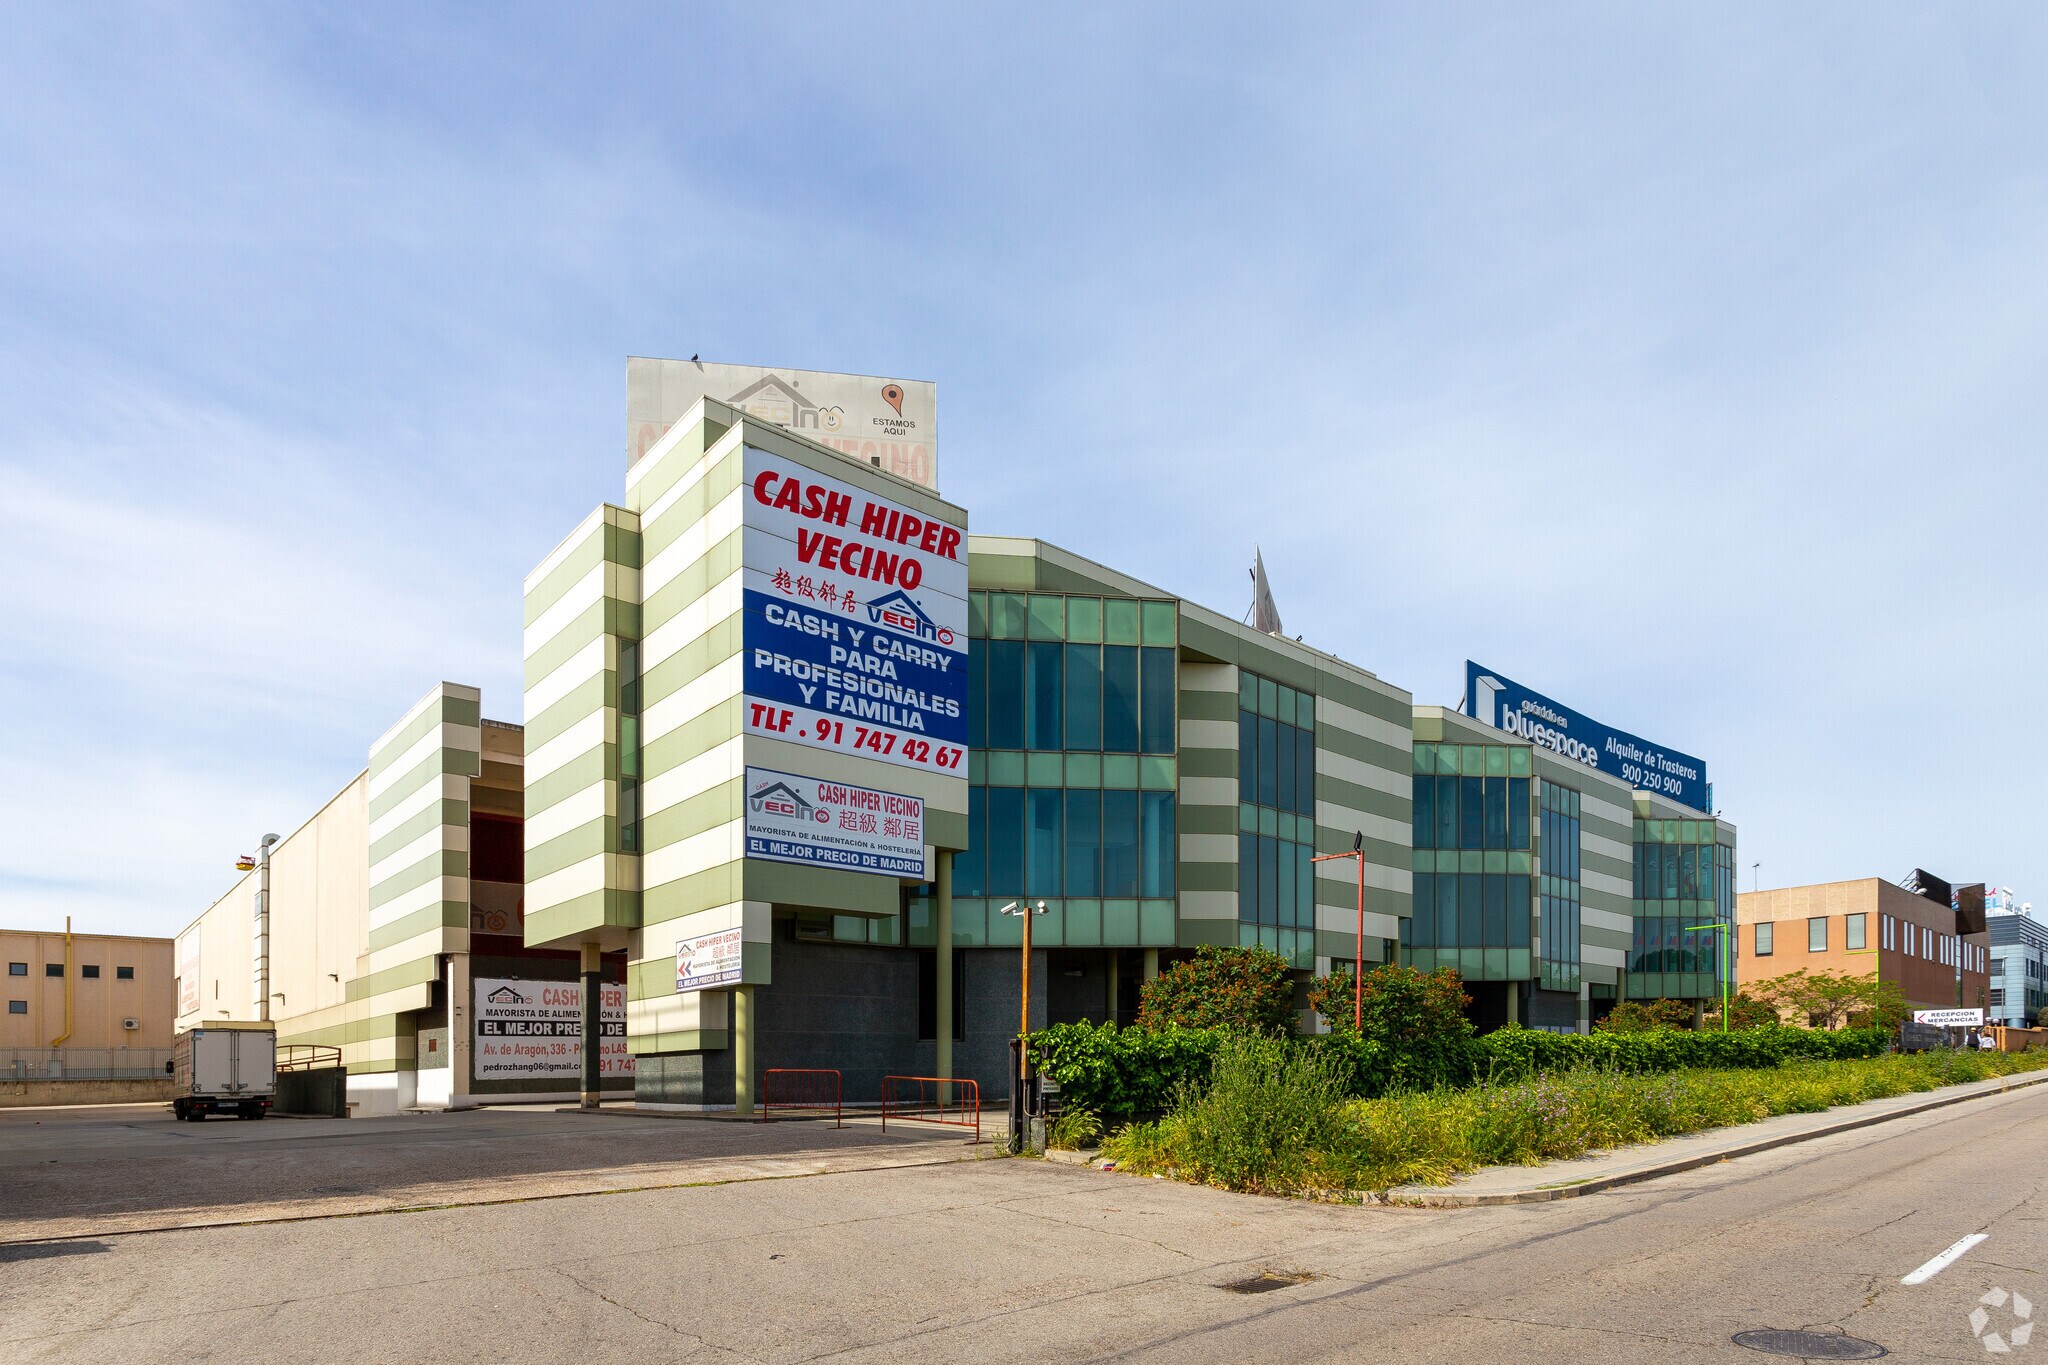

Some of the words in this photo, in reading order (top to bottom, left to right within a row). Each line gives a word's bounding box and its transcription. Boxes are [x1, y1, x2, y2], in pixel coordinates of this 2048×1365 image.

[873, 418, 915, 428] ESTAMOS
[884, 427, 906, 436] AQUI
[753, 470, 852, 527] CASH
[860, 502, 961, 560] HIPER
[796, 527, 922, 591] VECINO
[765, 603, 840, 641] CASH
[848, 627, 865, 647] Y
[873, 634, 952, 672] CARRY
[831, 646, 898, 680] PARA
[755, 648, 960, 718] PROFESIONALES
[798, 684, 818, 704] Y
[826, 690, 925, 731] FAMILIA
[816, 718, 843, 744] 91
[855, 721, 897, 754] 747
[901, 738, 931, 763] 42
[935, 744, 964, 769] 67
[1503, 704, 1598, 768] bluespace
[1605, 737, 1644, 763] Alquiler
[1644, 749, 1656, 766] de
[1656, 753, 1698, 781] Trasteros
[1622, 763, 1642, 783] 900
[1643, 771, 1662, 790] 250
[1663, 776, 1682, 796] 900
[818, 783, 848, 806] CASH
[850, 789, 880, 813] HIPER
[882, 795, 920, 819] VECINO
[749, 824, 796, 838] MAYORISTA
[798, 831, 810, 840] DE
[811, 832, 868, 848] ALIMENTACIÓN
[877, 843, 922, 856] HOSTELERÍA
[750, 840, 767, 853] EL
[770, 842, 814, 858] MEJOR
[816, 848, 860, 865] PRECIO
[862, 856, 878, 868] DE
[880, 858, 922, 872] MADRID
[486, 1008, 536, 1018] MAYORISTA
[538, 1010, 550, 1018] DE
[615, 1011, 621, 1019] &
[542, 988, 579, 1006] CASH
[600, 990, 622, 1007] PER
[484, 1022, 502, 1035] EL
[505, 1022, 552, 1036] MEJOR
[606, 1023, 623, 1036] DE
[483, 1062, 581, 1073] pedrozhang06@gmail.c
[600, 1060, 612, 1072] 91
[484, 1044, 498, 1055] Av.
[500, 1044, 512, 1055] de
[514, 1043, 549, 1058] Aragón,
[550, 1043, 566, 1055] 336
